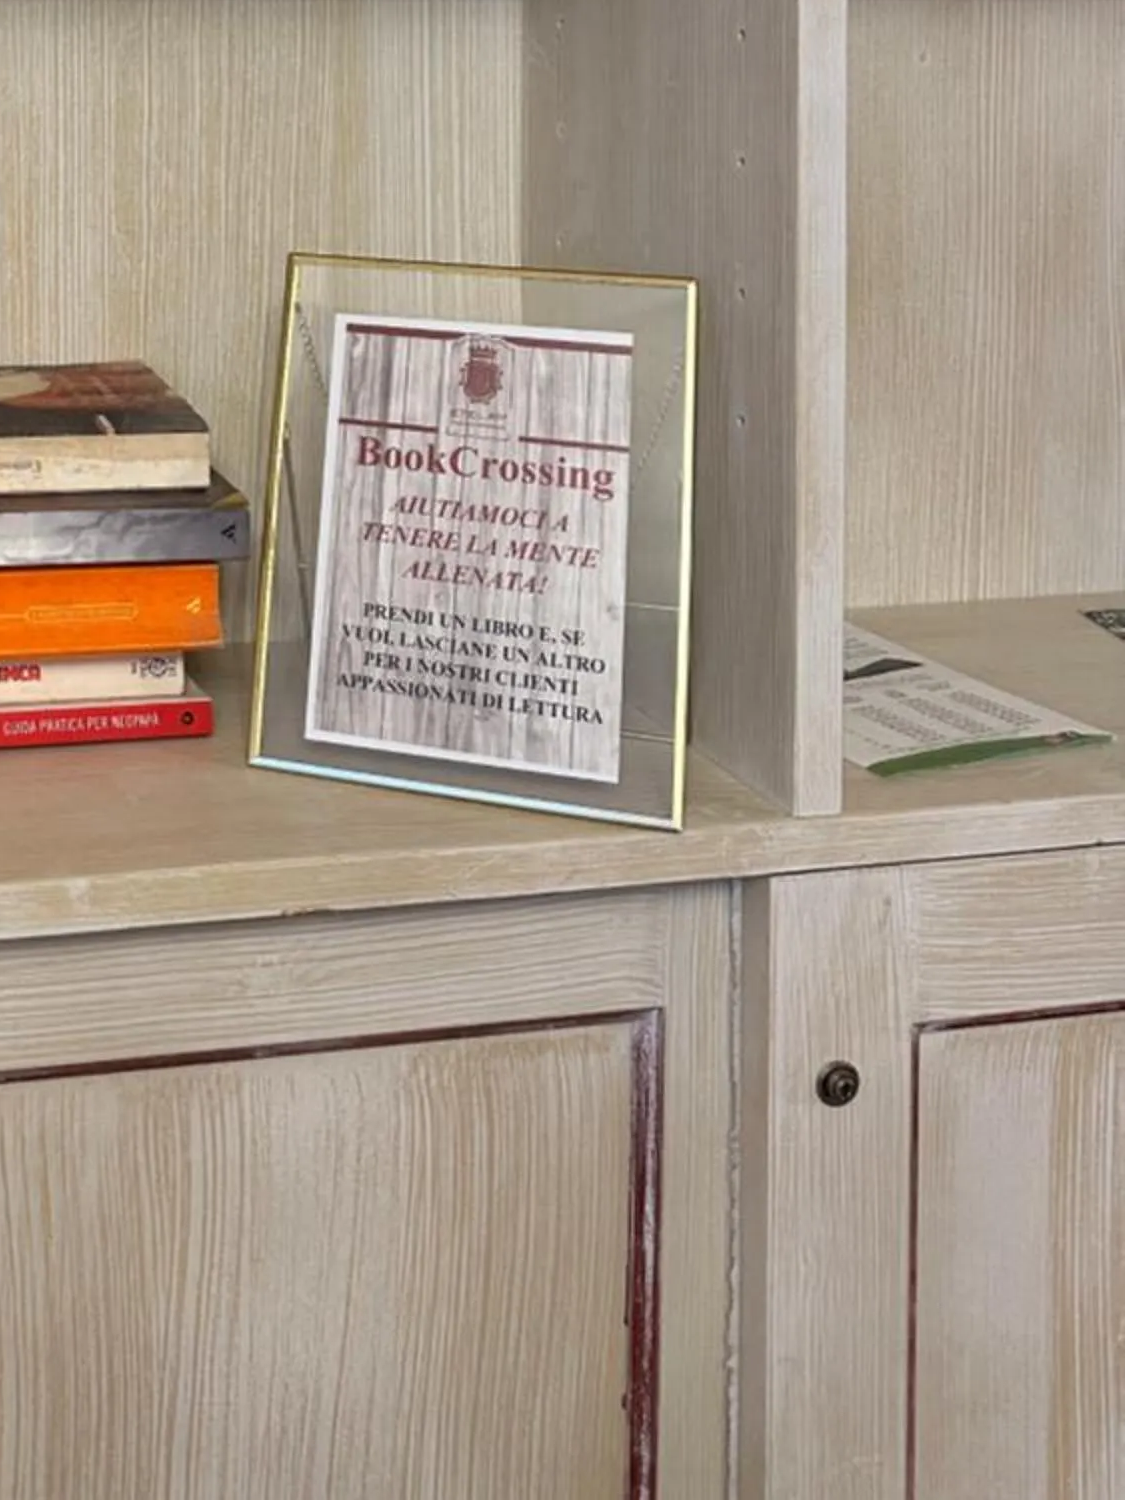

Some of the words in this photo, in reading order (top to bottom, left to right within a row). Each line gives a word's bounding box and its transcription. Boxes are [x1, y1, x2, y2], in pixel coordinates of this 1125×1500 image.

[357, 435, 615, 502] BookCrossing
[390, 496, 549, 532] AIUTIAMOCI
[552, 514, 569, 532] A
[363, 521, 460, 551] TENERE
[466, 534, 497, 556] LA
[504, 540, 600, 568] MENTE
[402, 560, 549, 595] ALLENATA!
[363, 602, 434, 627] PRENDI
[439, 613, 466, 630] UN
[472, 617, 533, 639] LIBRO
[561, 629, 586, 647] SE
[363, 651, 400, 669] PER
[405, 656, 413, 672] I
[417, 658, 490, 684] NOSTRI
[495, 670, 578, 696] CLIENTI
[400, 631, 499, 659] LASCIANE
[503, 646, 529, 664] UN
[535, 651, 606, 675] ALTRO
[337, 673, 476, 707] APPASSIONATI
[482, 692, 502, 711] DI
[508, 696, 604, 725] LETTURA
[3, 719, 37, 736] GUIDA
[39, 717, 85, 732] PRATICA
[87, 716, 108, 731] PER
